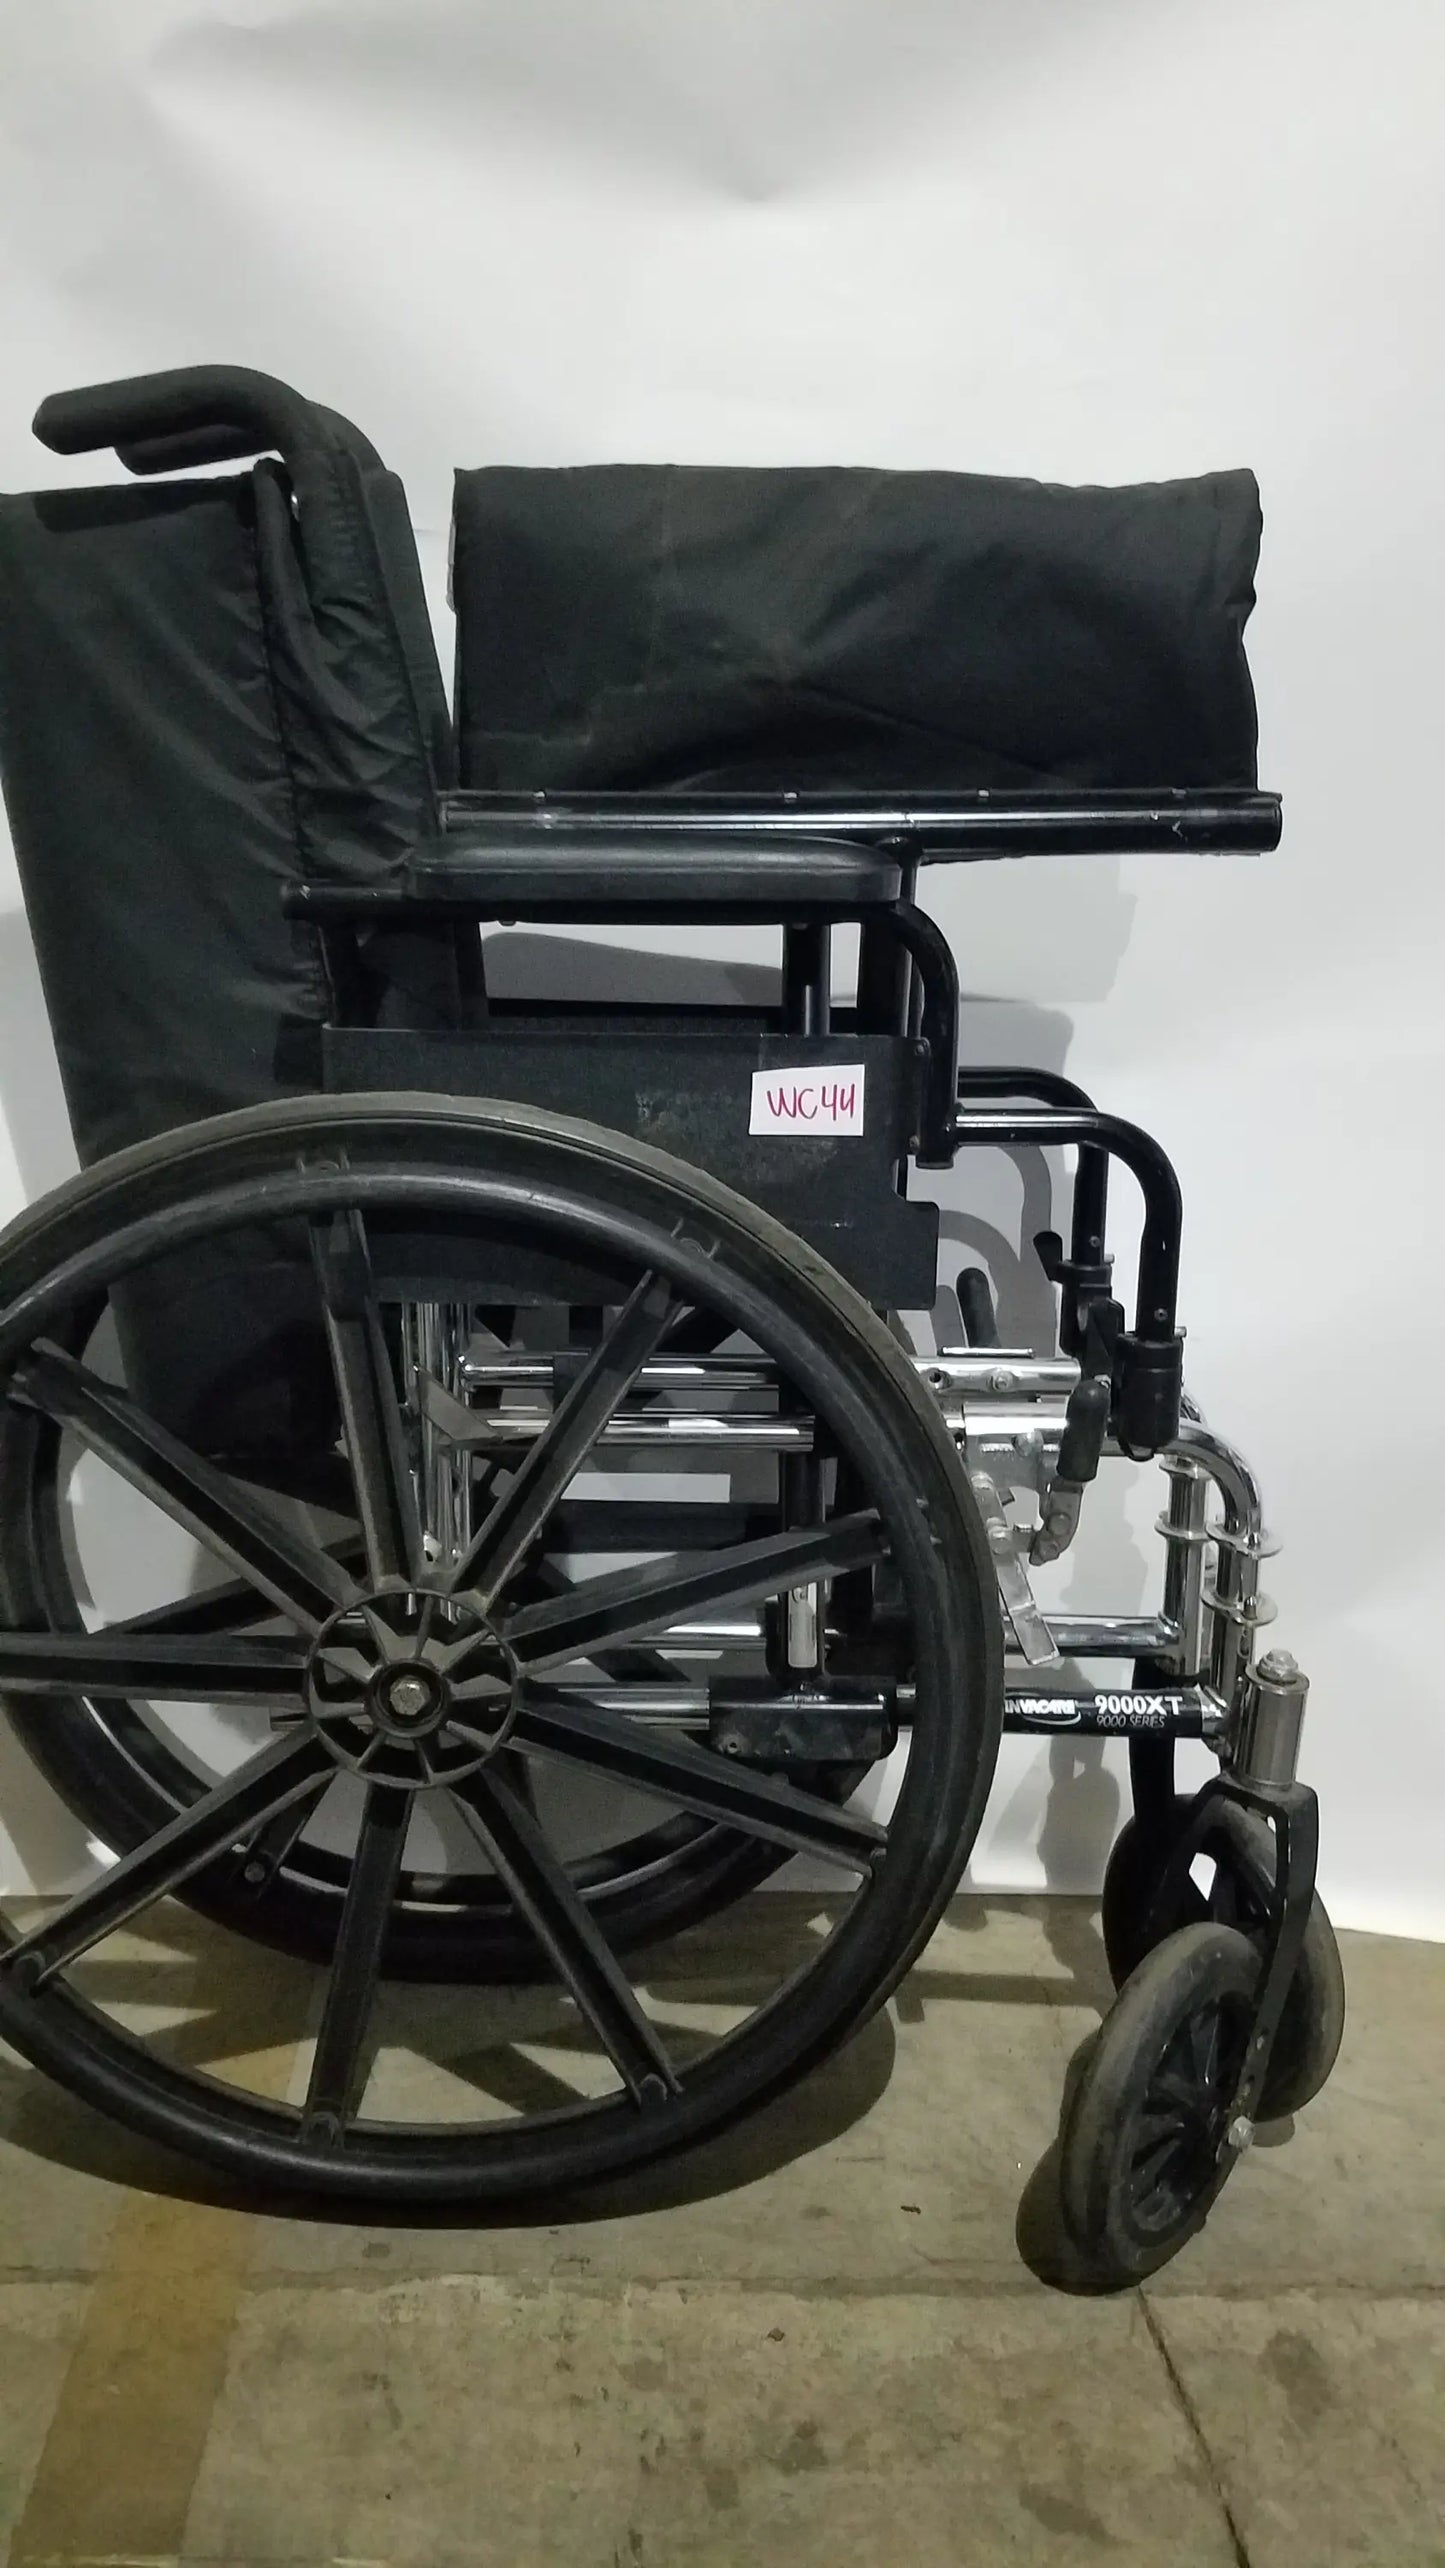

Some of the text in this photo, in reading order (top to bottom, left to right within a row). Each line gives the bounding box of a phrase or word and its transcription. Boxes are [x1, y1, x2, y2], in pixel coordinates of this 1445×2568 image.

[766, 1083, 856, 1121] WC44
[1094, 1694, 1183, 1715] 9000XT
[1096, 1714, 1166, 1728] 9000 SERIES
